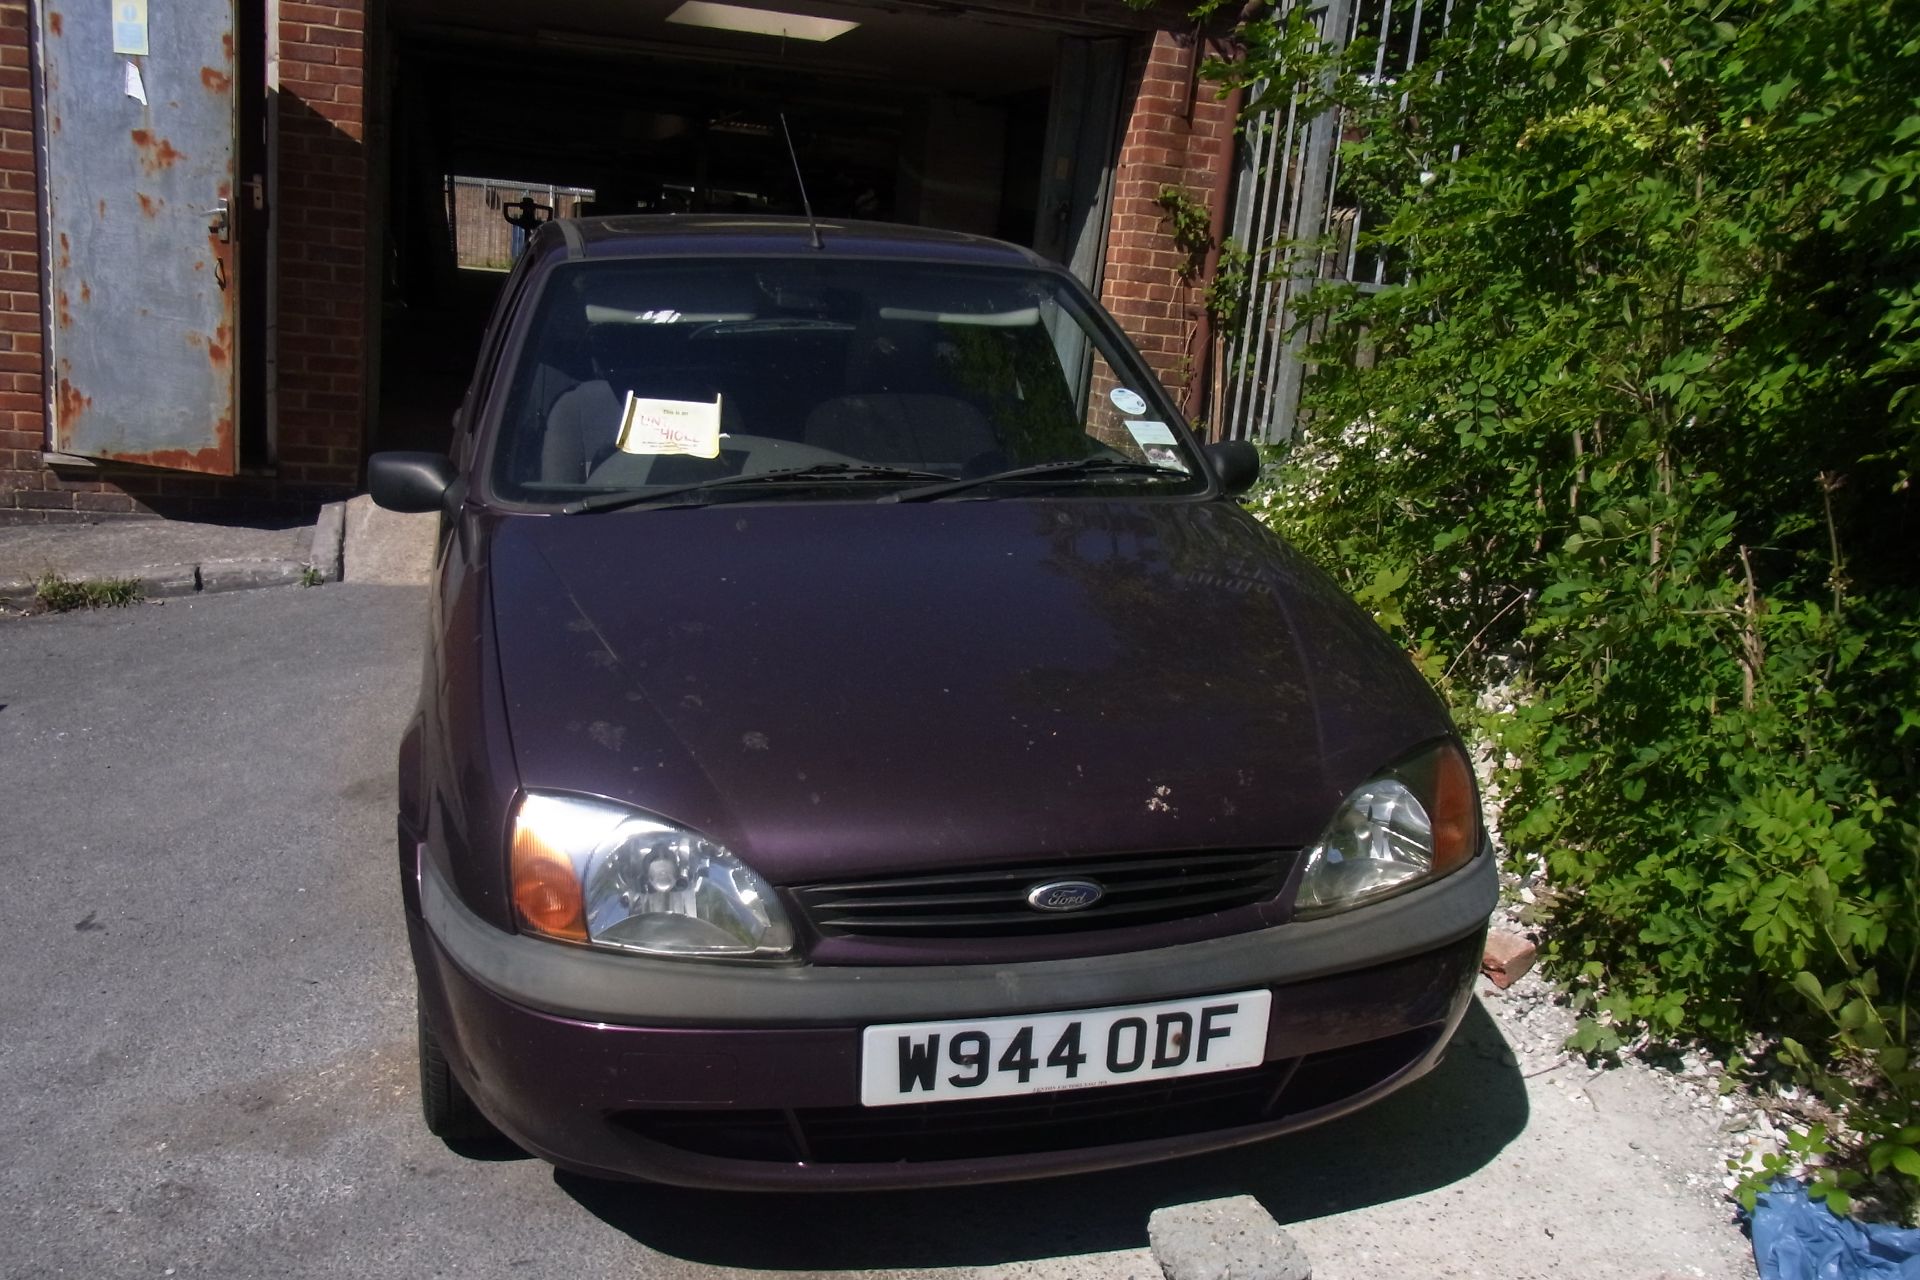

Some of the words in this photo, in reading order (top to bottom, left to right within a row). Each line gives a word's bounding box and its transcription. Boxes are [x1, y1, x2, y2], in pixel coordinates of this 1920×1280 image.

[1048, 889, 1087, 905] Ford
[898, 1022, 1086, 1093] W944
[1106, 1003, 1239, 1074] ODF
